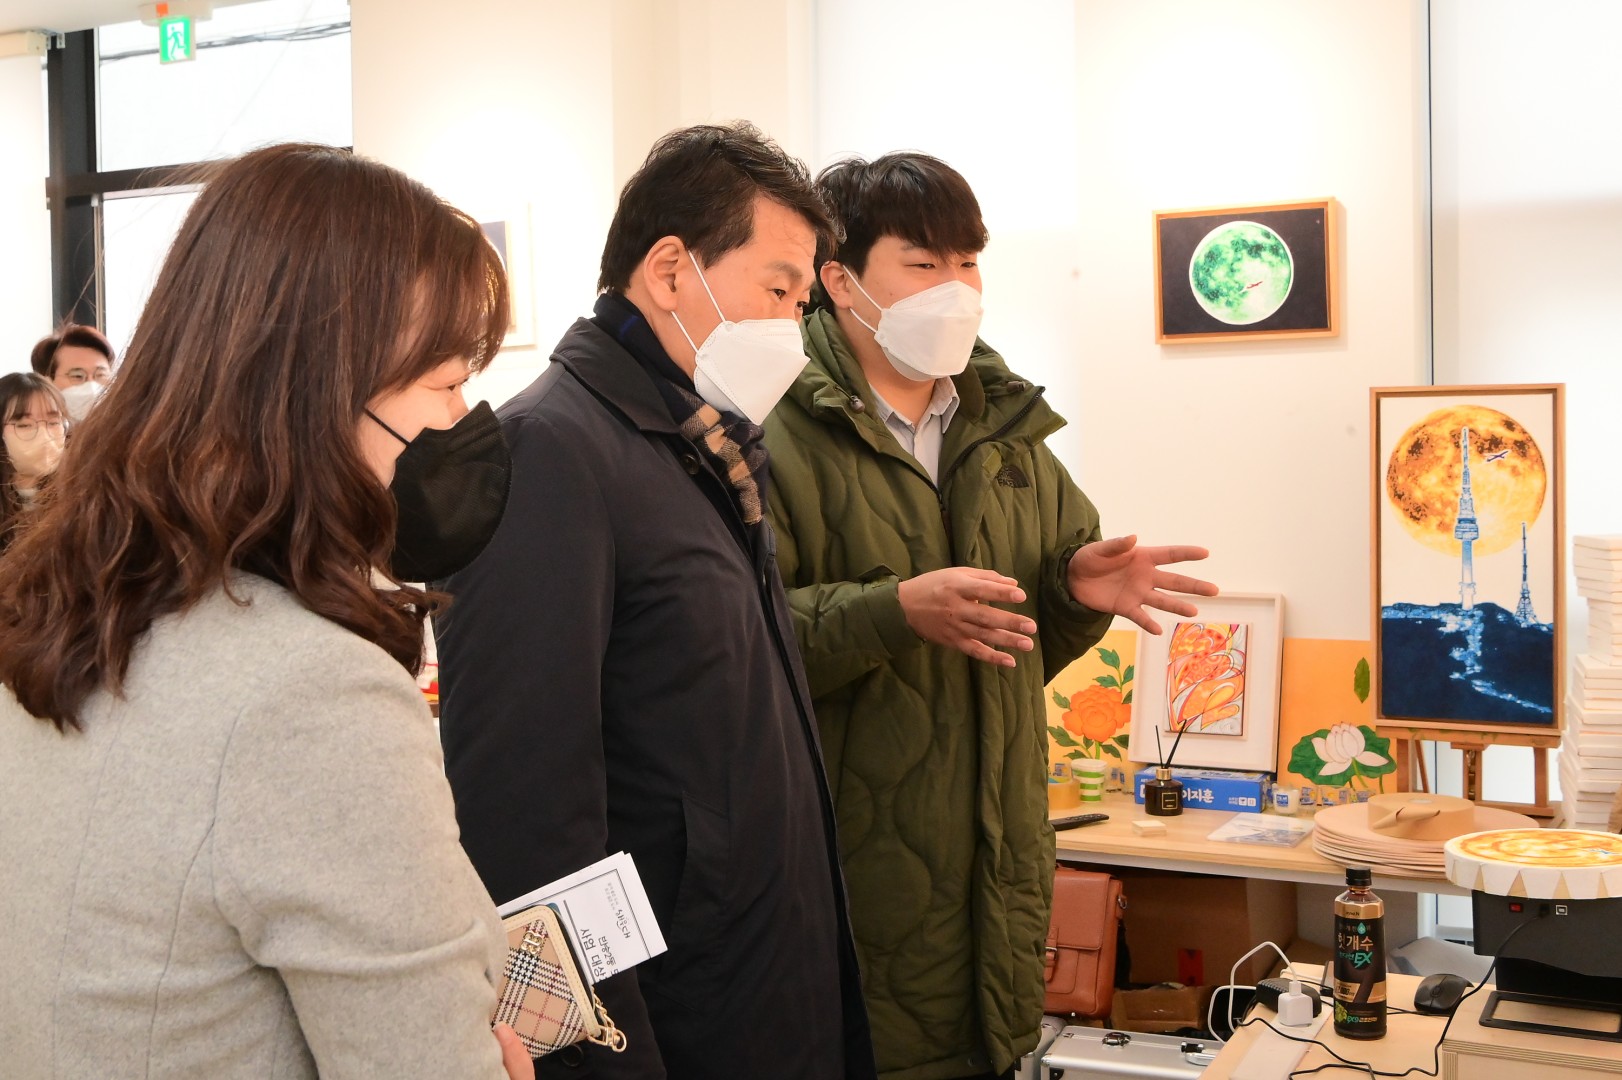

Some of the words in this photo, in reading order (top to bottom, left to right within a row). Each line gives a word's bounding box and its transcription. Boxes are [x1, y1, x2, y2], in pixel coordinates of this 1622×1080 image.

[1182, 787, 1215, 803] 이지훈
[599, 936, 617, 966] 반송2동
[1337, 932, 1374, 951] 헛개수
[580, 928, 596, 951] 사업
[591, 955, 608, 980] 대상
